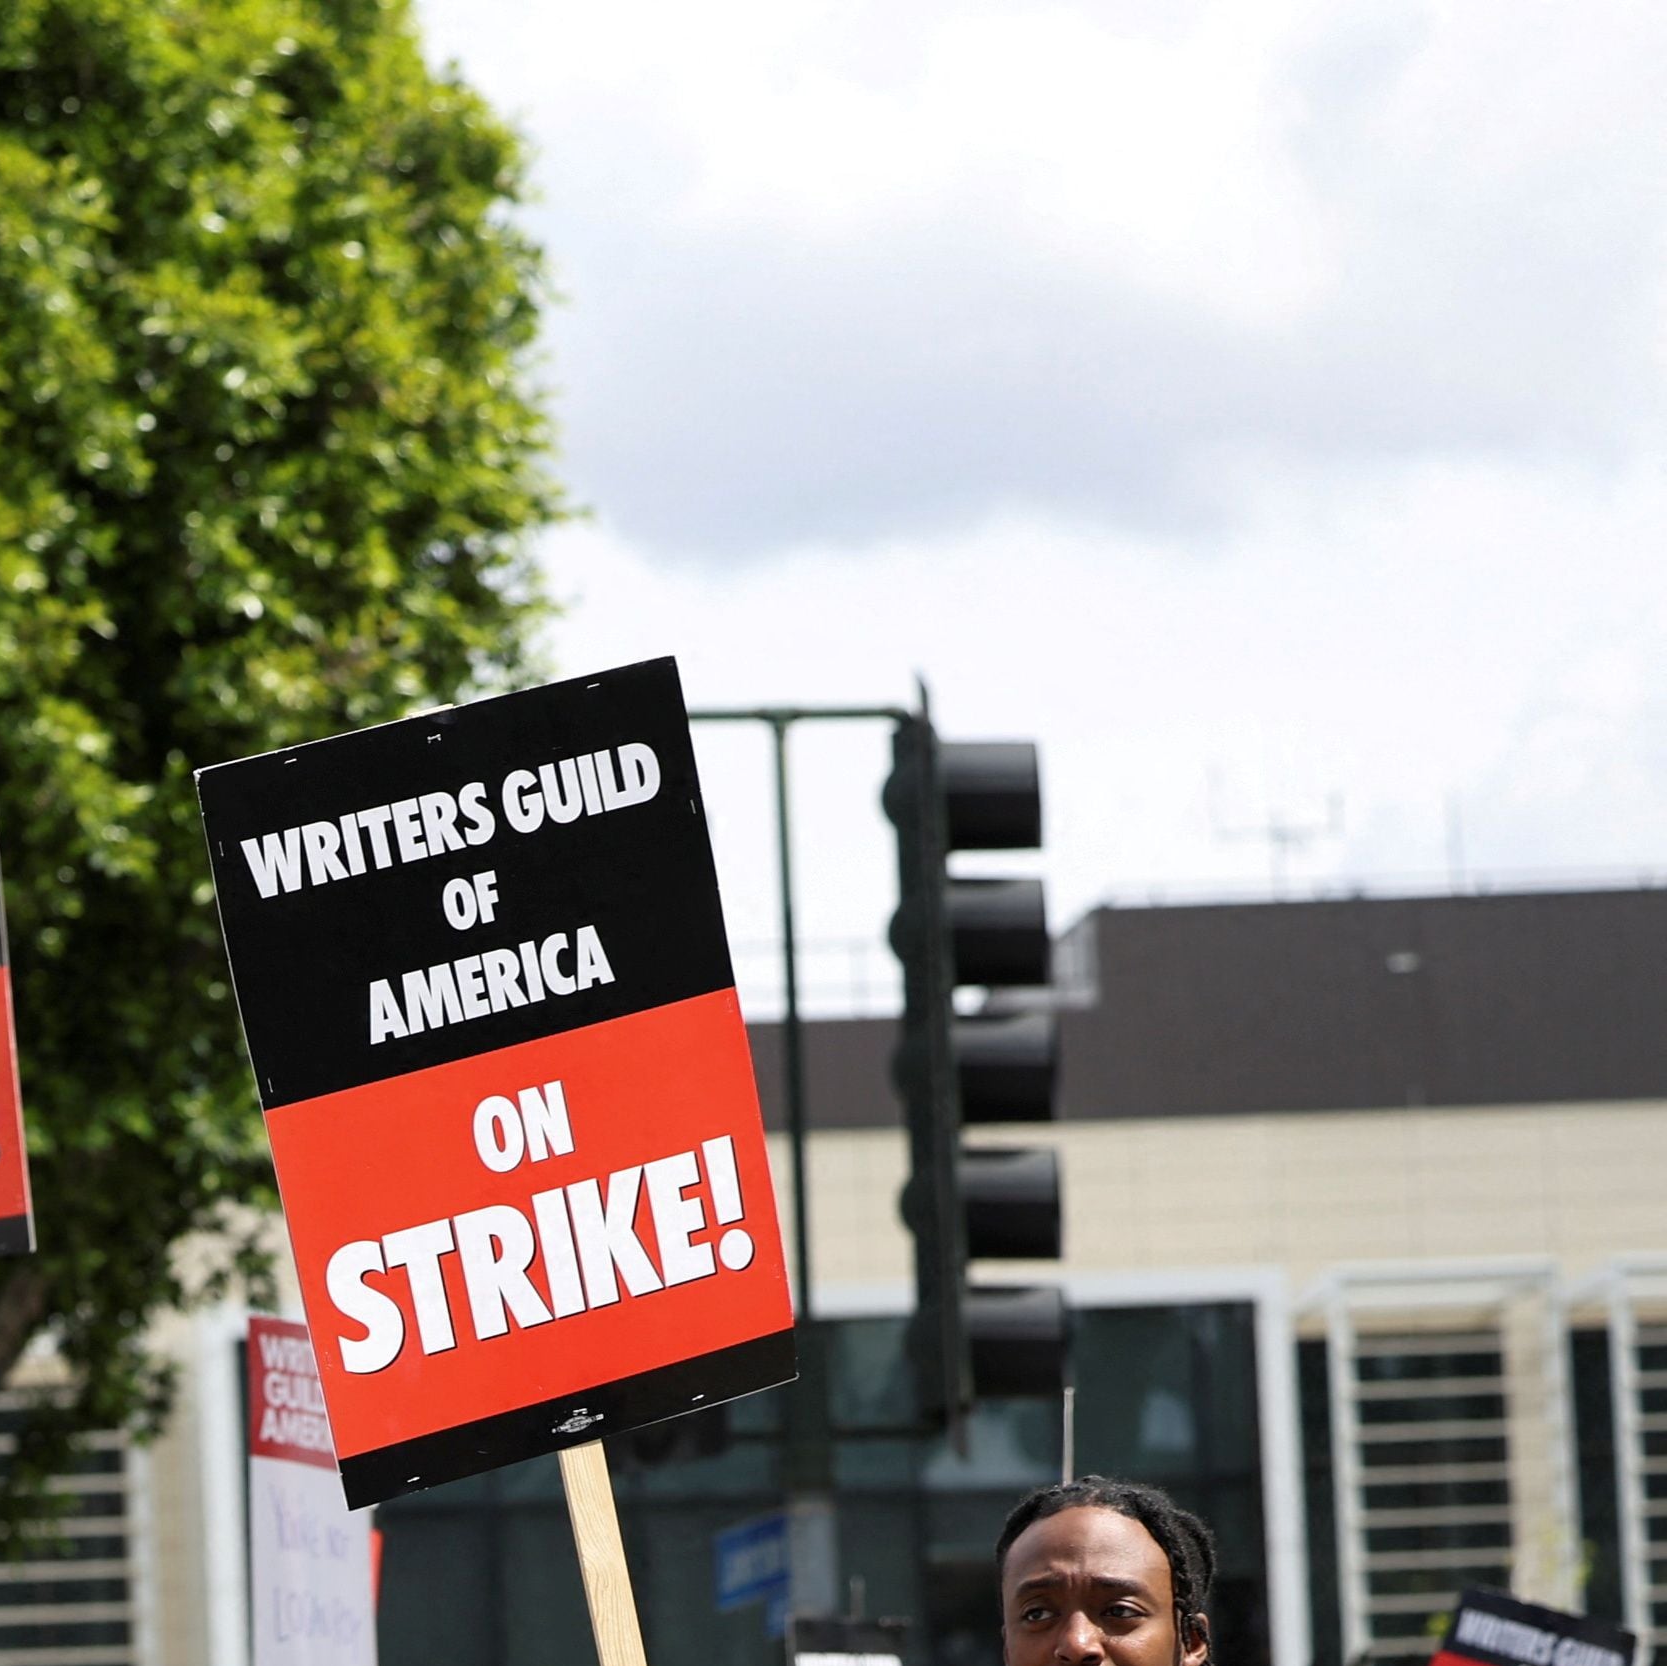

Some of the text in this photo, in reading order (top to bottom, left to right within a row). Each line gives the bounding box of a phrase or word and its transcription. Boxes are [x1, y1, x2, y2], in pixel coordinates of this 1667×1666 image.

[239, 741, 661, 899] WRITERS GUILD
[442, 870, 500, 931] OF
[367, 925, 615, 1046] AMERICA
[471, 1080, 576, 1175] ON
[323, 1135, 756, 1376] STRIKE!
